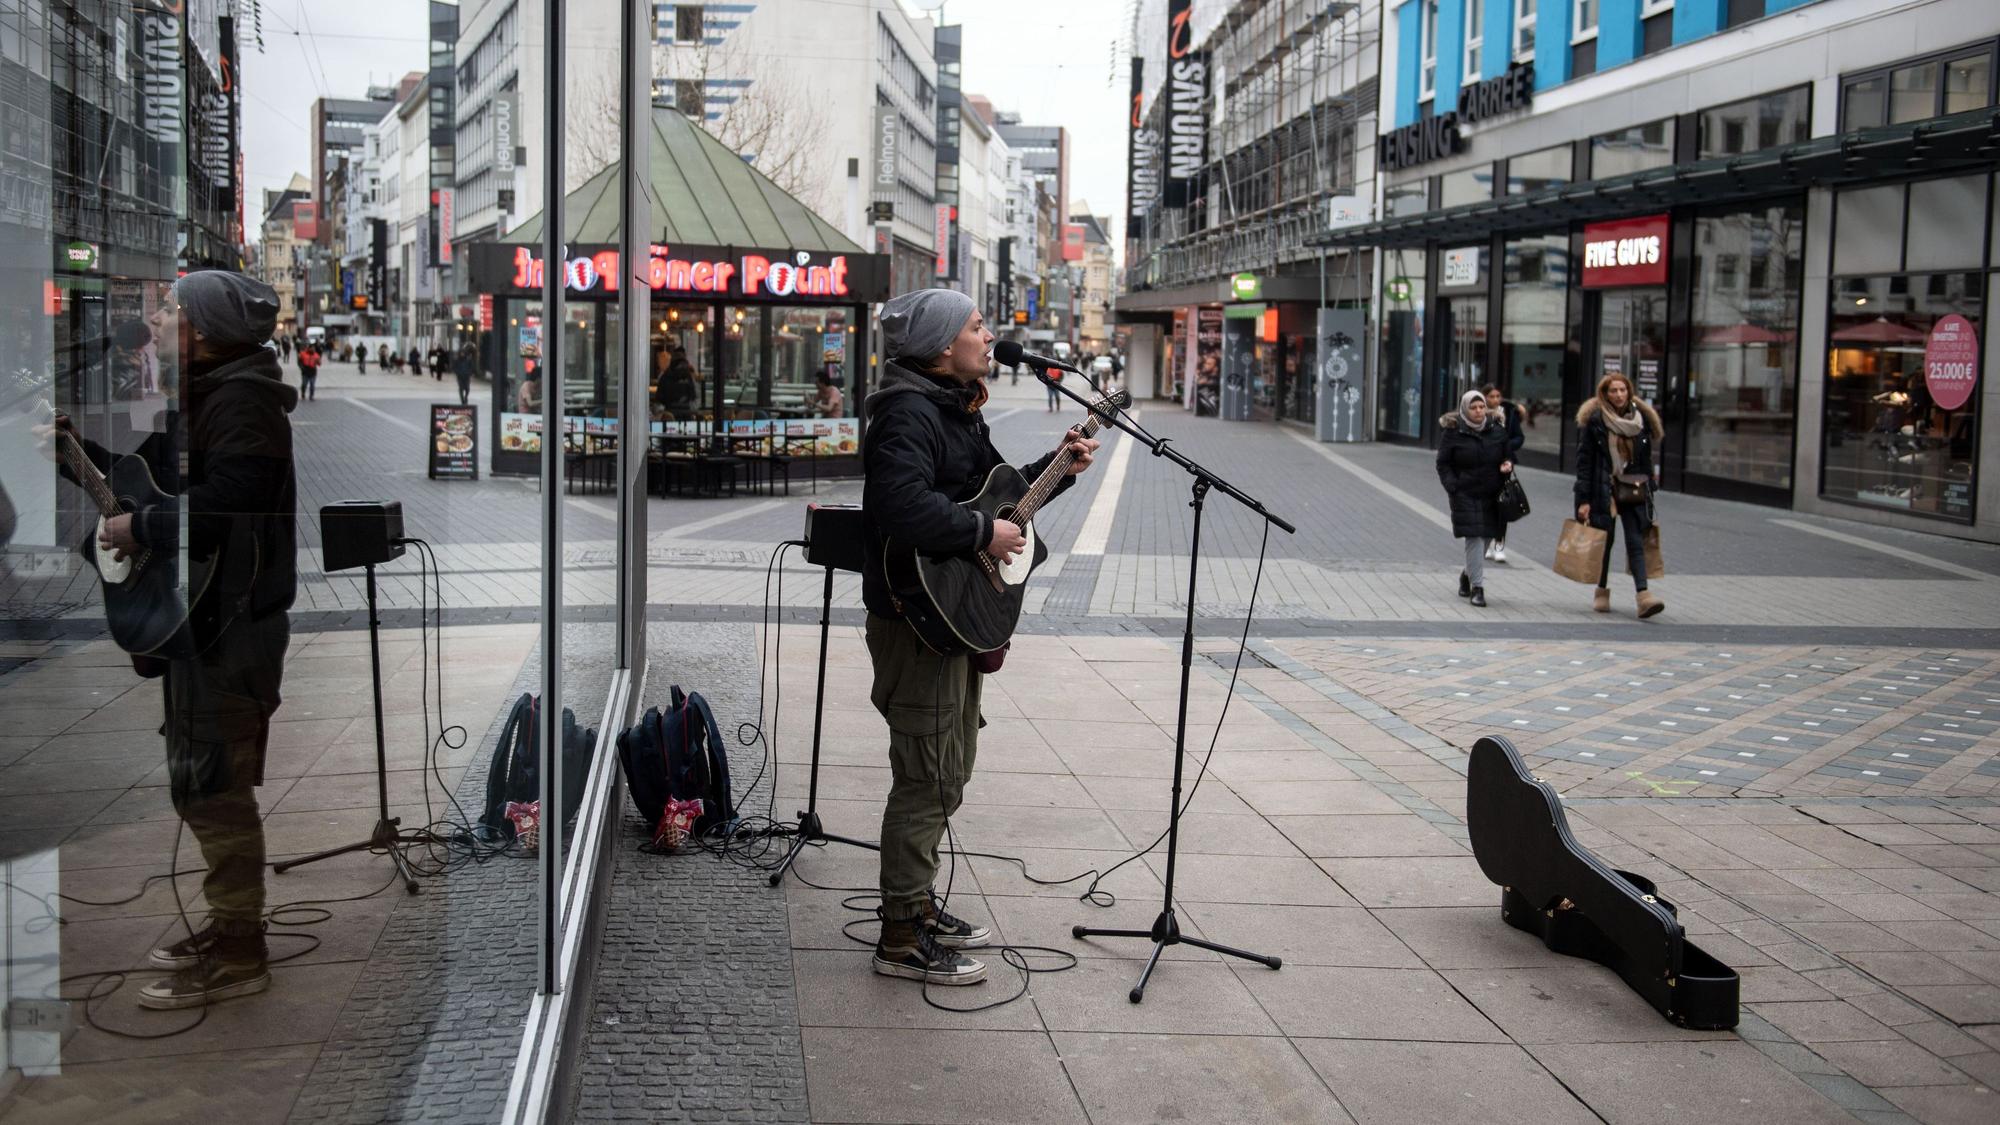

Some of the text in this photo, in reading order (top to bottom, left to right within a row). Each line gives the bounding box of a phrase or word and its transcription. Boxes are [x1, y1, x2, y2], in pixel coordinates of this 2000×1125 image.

[1170, 61, 1205, 179] SATURN
[1376, 112, 1457, 171] LENSING
[1132, 129, 1158, 216] SATURN
[650, 245, 848, 296] öner Point
[1585, 235, 1660, 268] FIVE GUYS
[1929, 362, 1972, 380] 25.000 €
